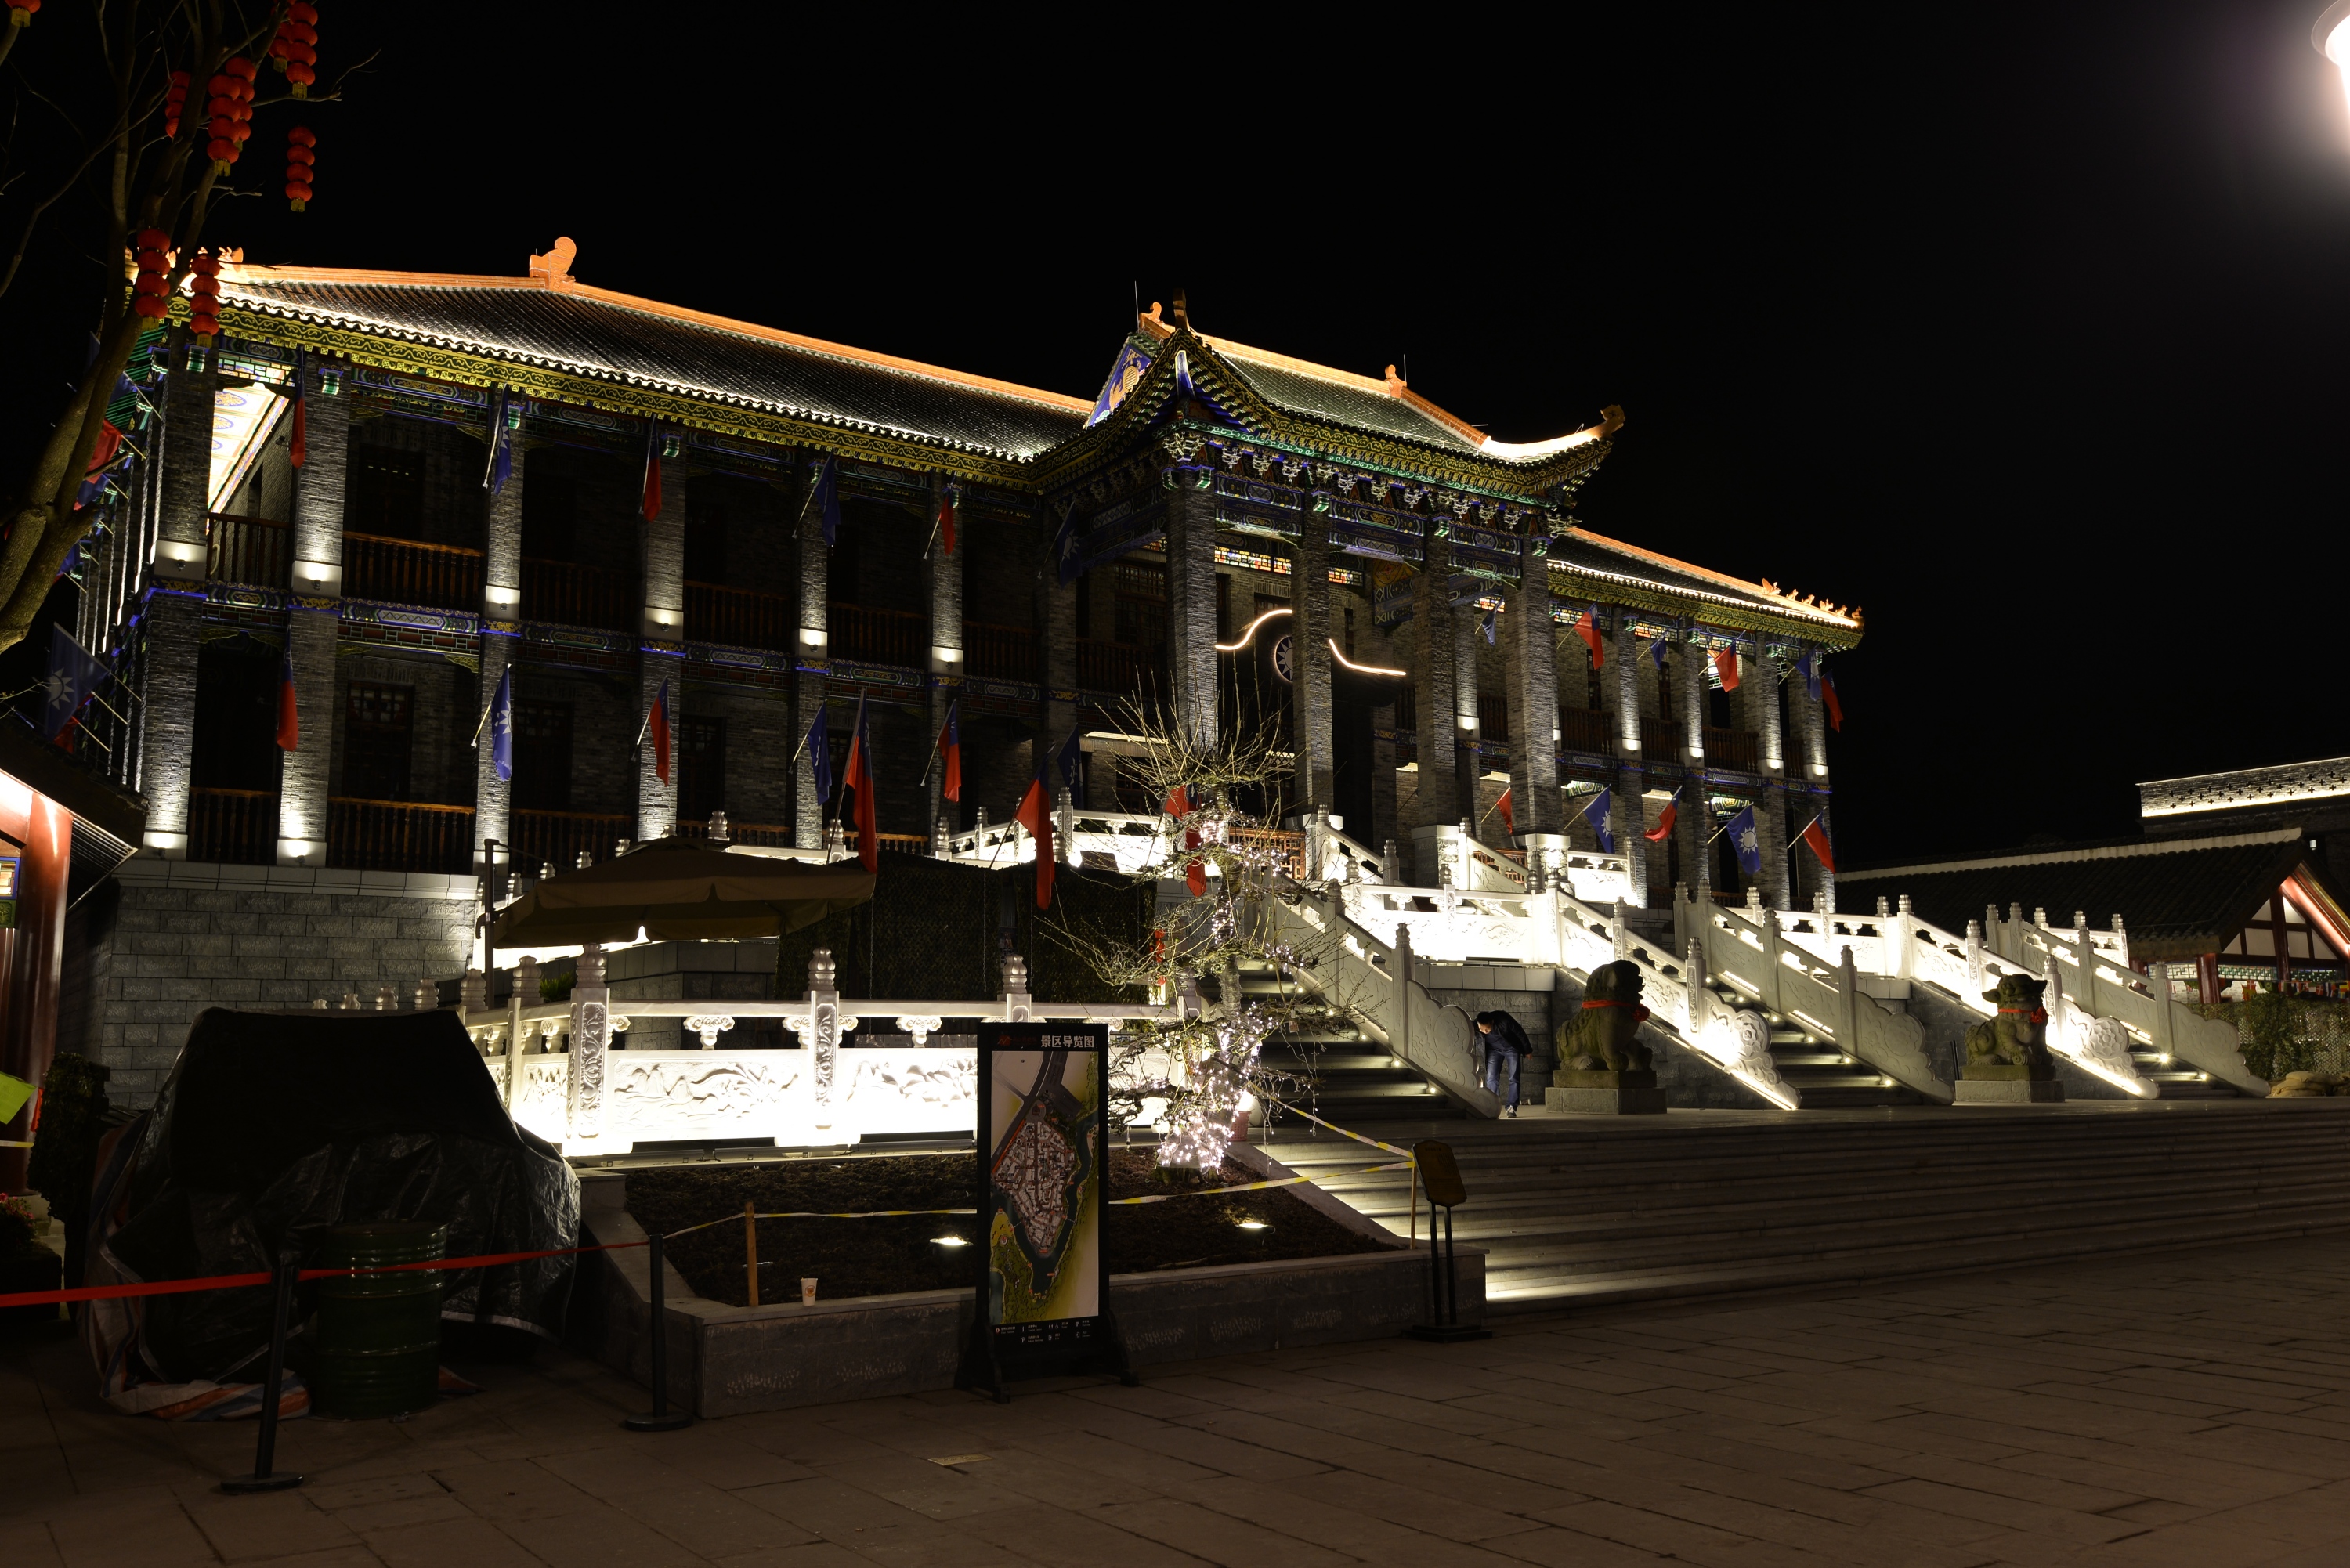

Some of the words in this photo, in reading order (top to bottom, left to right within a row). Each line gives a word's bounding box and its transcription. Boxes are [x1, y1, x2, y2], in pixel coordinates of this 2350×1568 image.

[1040, 1035, 1095, 1048] 景区导览图
